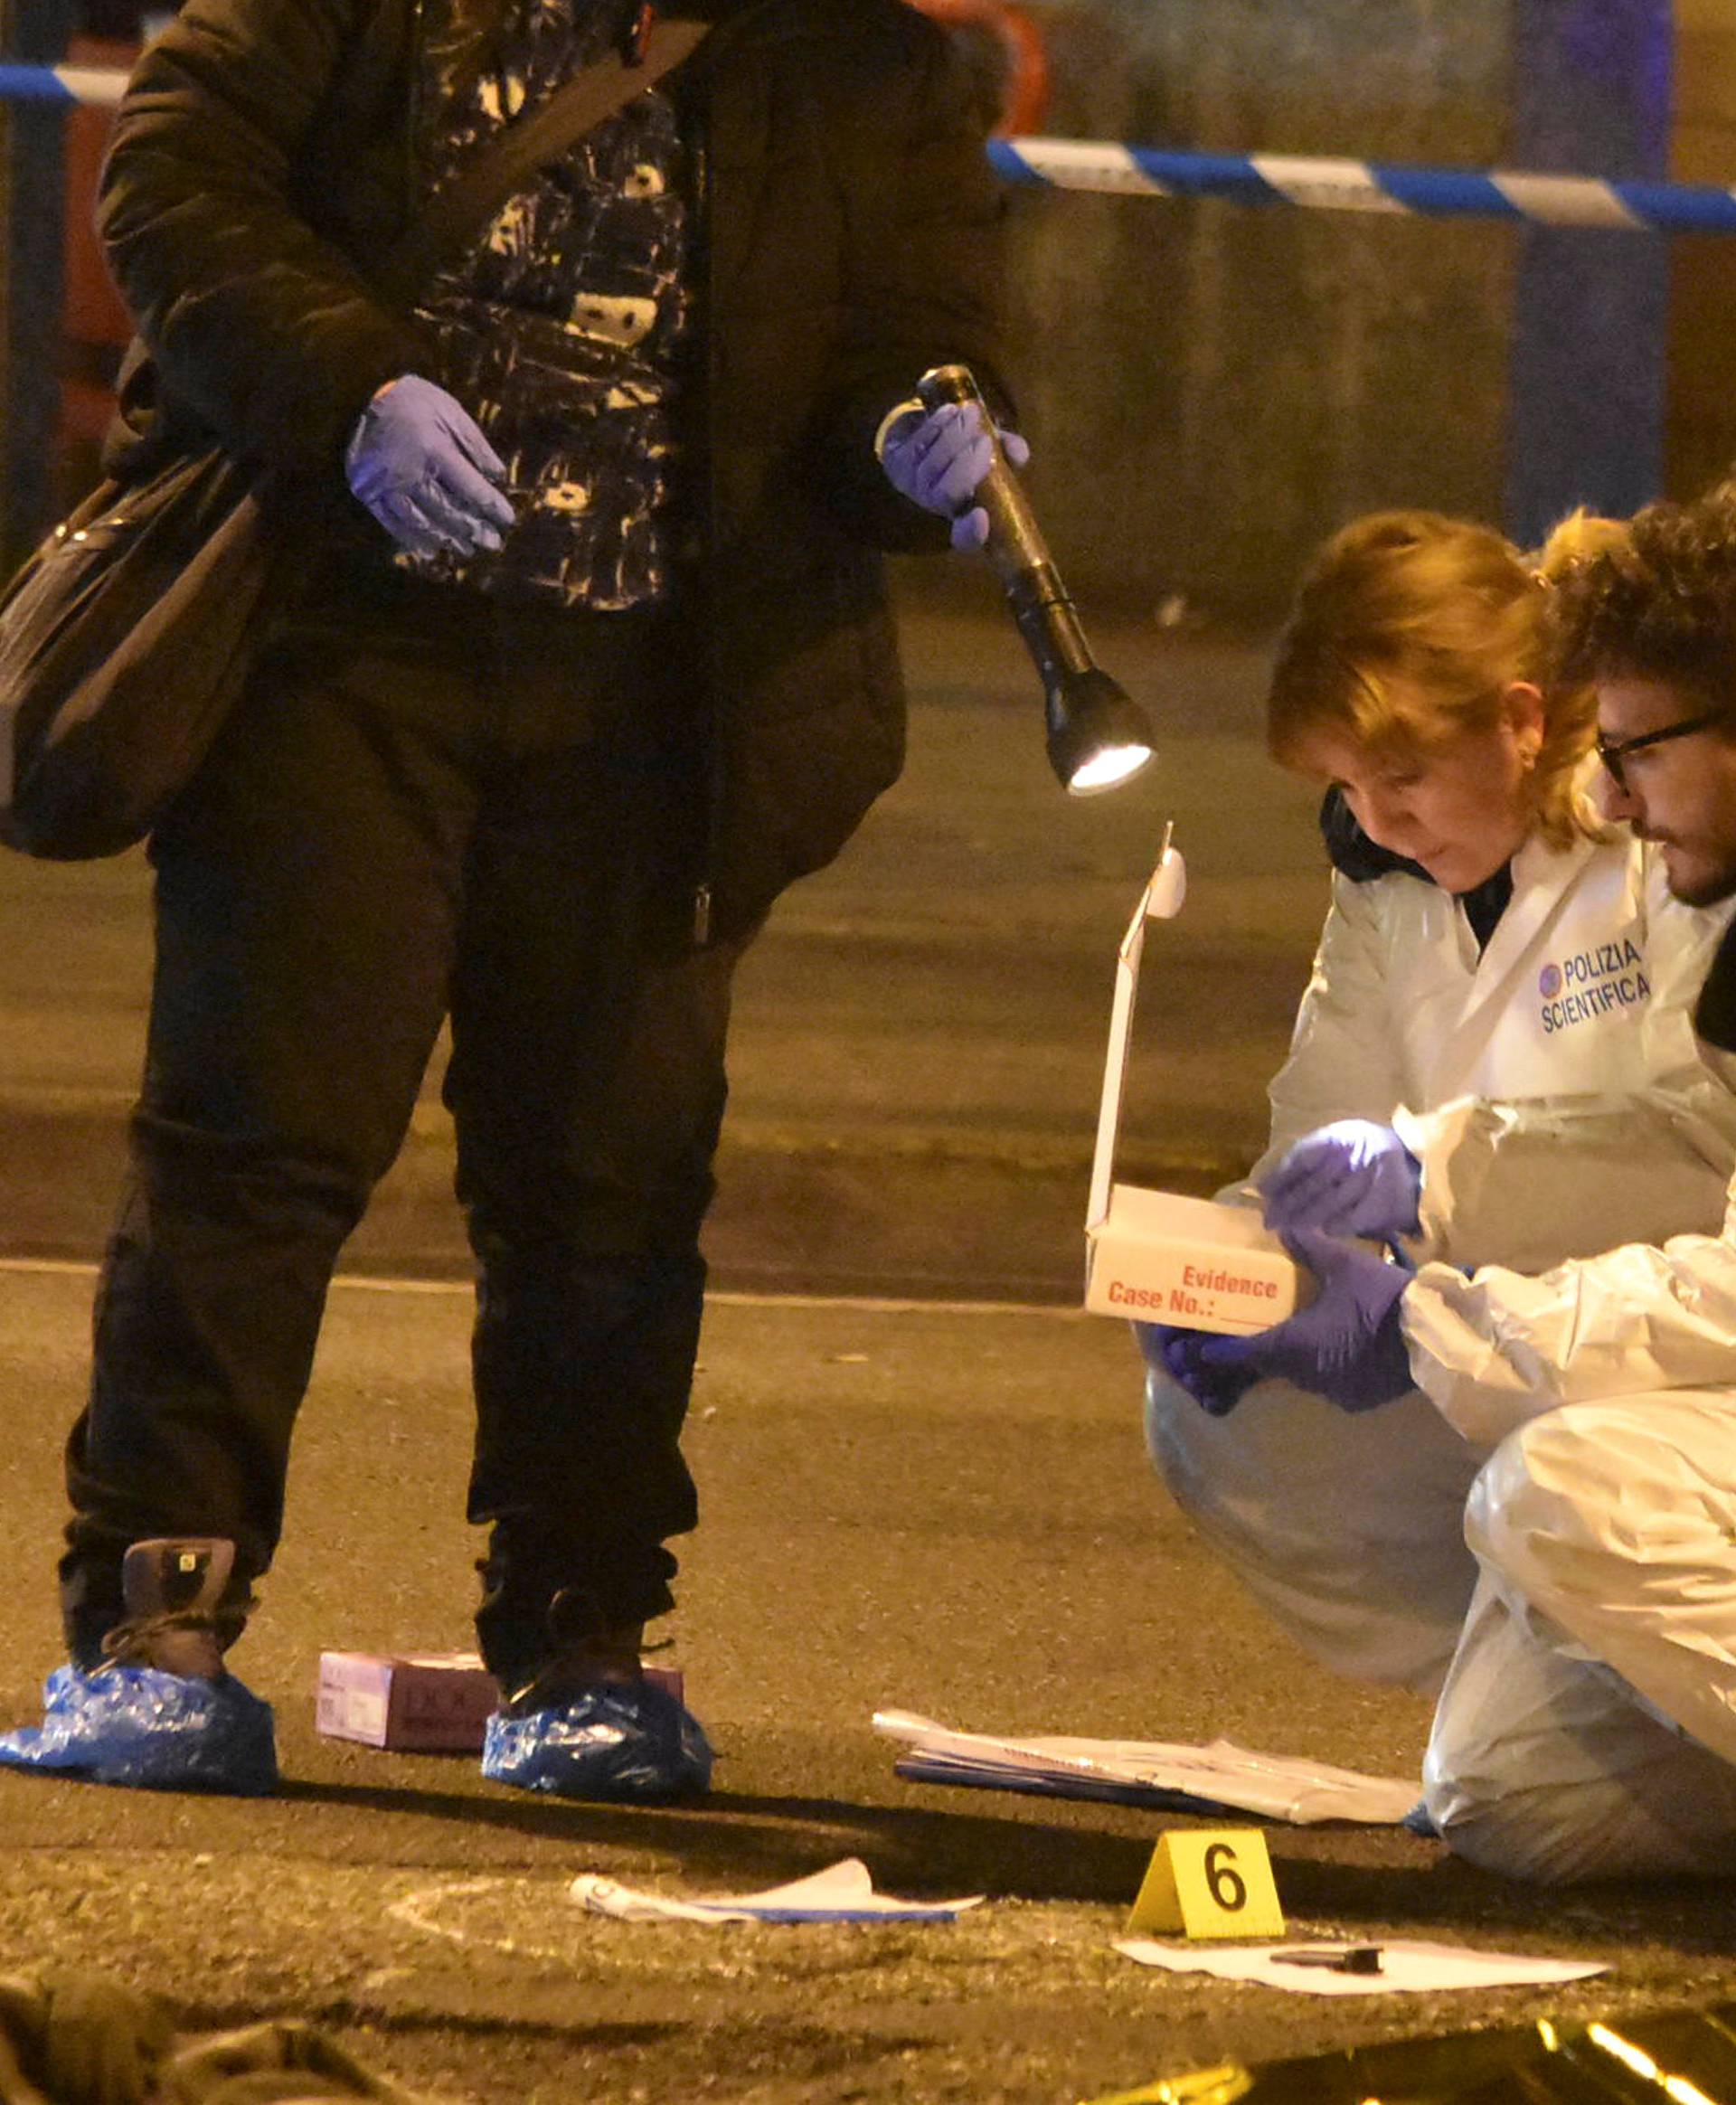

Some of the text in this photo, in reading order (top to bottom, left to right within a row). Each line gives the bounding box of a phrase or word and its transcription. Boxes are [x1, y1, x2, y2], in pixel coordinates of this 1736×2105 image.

[1563, 938, 1641, 986] POLIZIA
[1541, 972, 1651, 1034] SCIENTIFICA
[1109, 1280, 1214, 1317] Case No.:
[1183, 1265, 1278, 1298] Evidence
[1204, 1843, 1247, 1912] 6
